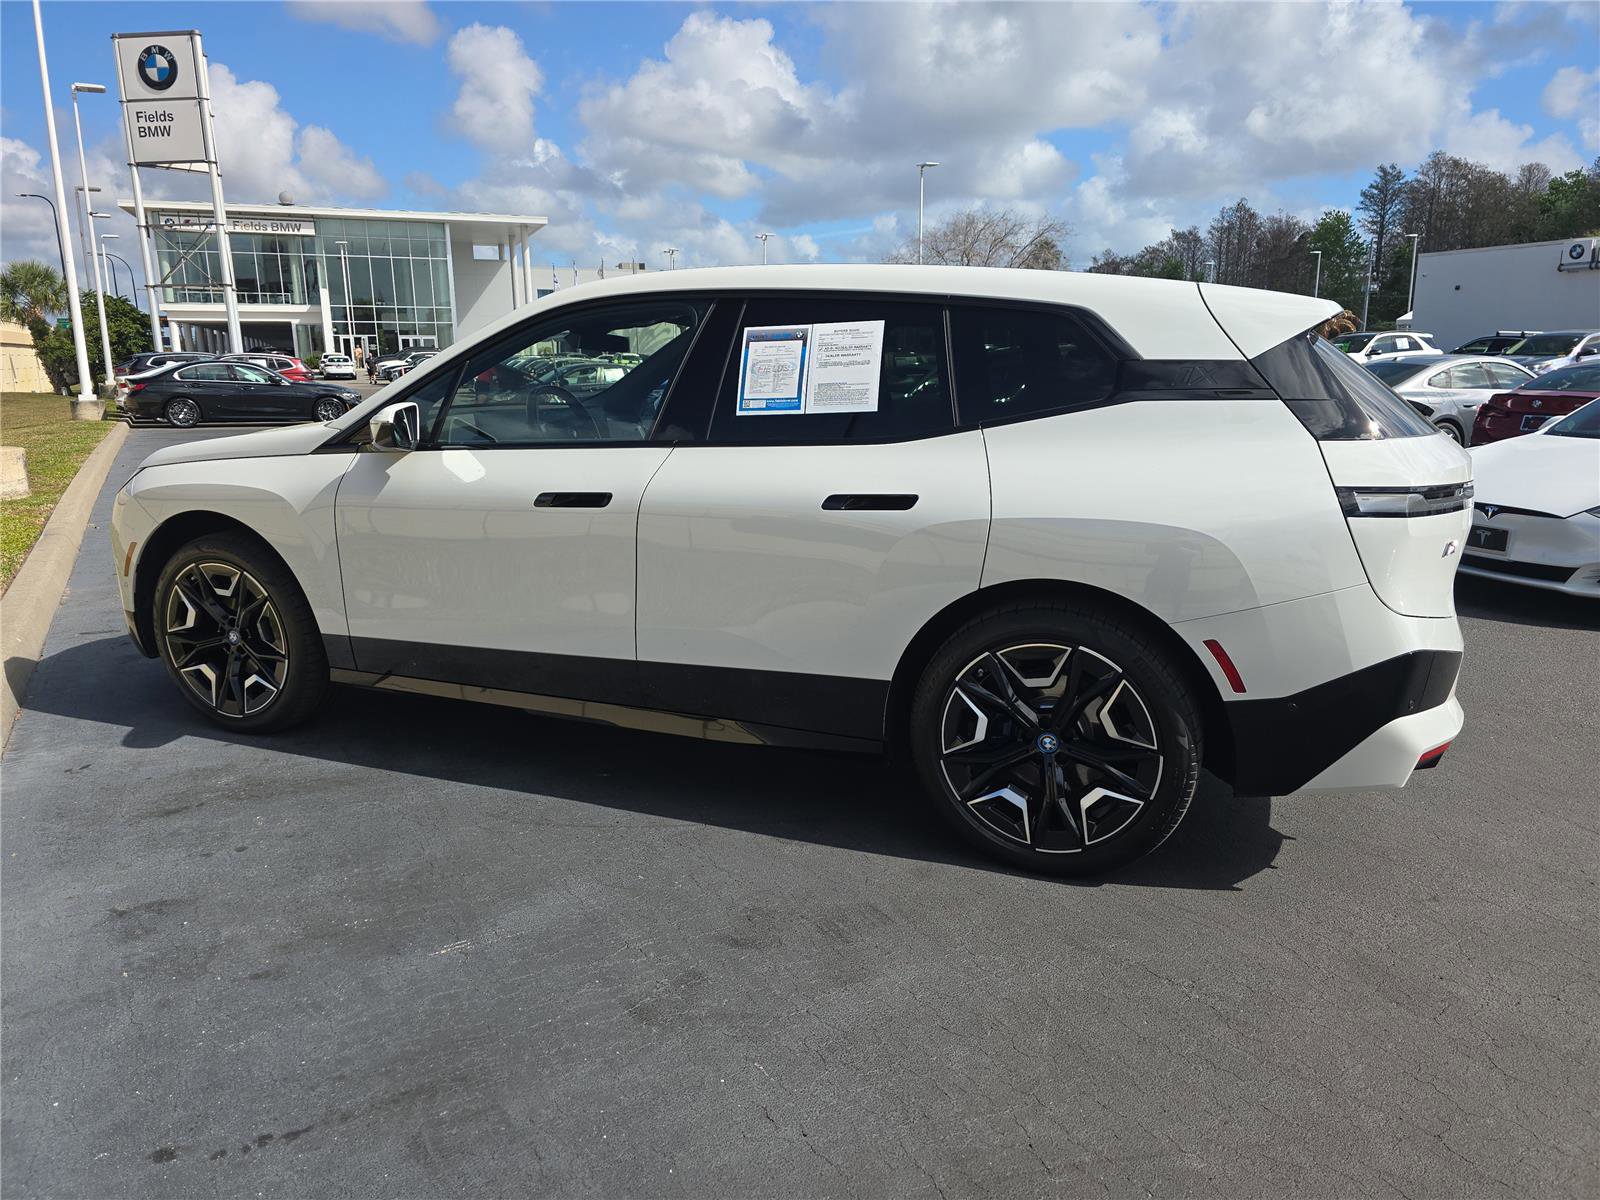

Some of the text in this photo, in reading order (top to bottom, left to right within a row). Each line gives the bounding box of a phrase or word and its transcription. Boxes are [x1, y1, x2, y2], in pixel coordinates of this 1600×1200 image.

[140, 46, 174, 61] BMW
[136, 110, 174, 122] Fields
[138, 125, 171, 137] BMW
[233, 220, 302, 232] Fields BMW
